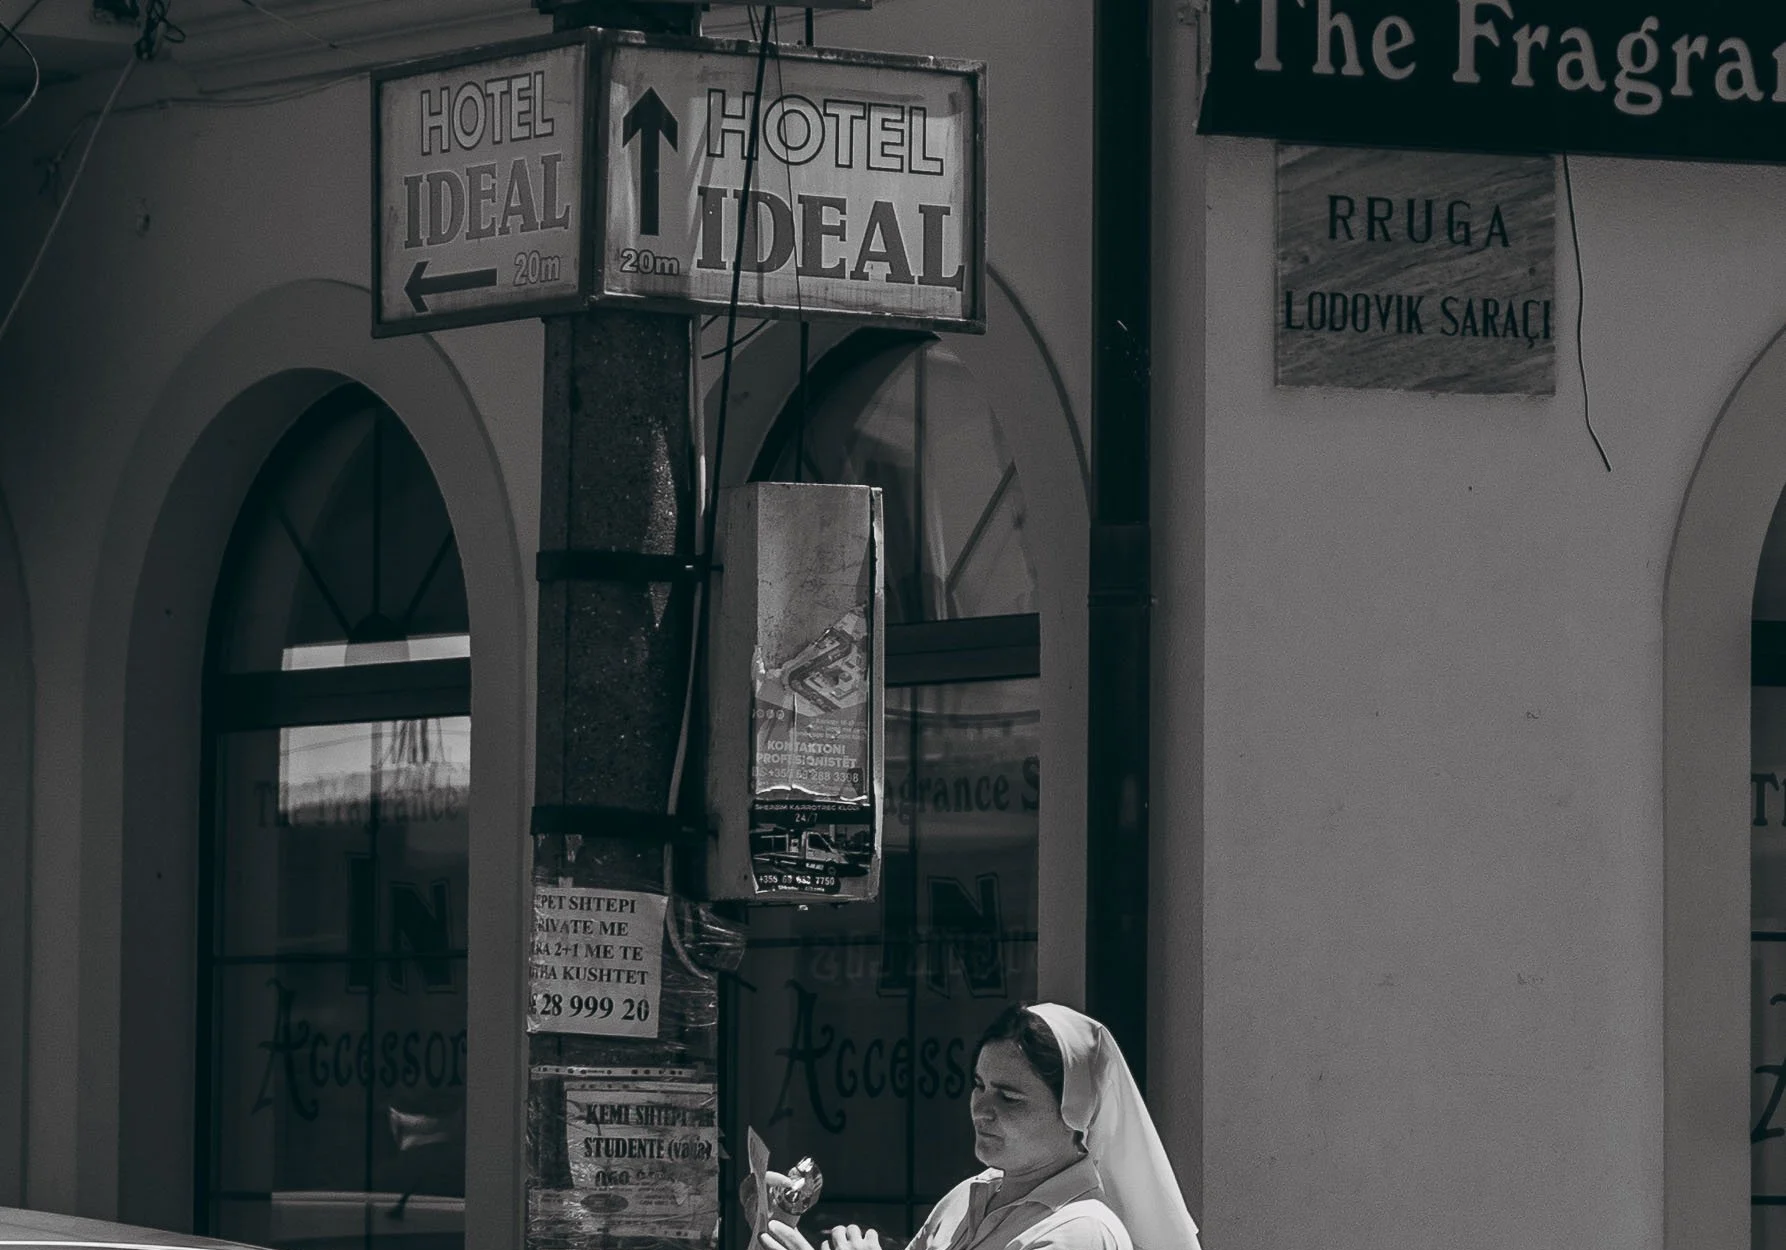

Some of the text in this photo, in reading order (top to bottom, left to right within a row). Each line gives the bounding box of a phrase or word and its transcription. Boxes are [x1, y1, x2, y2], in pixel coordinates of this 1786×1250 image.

[1253, 0, 1417, 80] The
[420, 70, 554, 156] HOTEL
[706, 88, 944, 177] HOTEL
[403, 153, 570, 249] IDEAL
[1327, 194, 1512, 249] RRUGA
[697, 185, 966, 292] IDEAL
[514, 250, 561, 287] 20m
[620, 248, 680, 276] 20m
[1284, 291, 1552, 349] LODOVIK SARAÇI
[795, 812, 818, 823] 24/7
[569, 895, 637, 913] SHTEPI
[599, 921, 629, 936] ME
[554, 942, 579, 957] 2+1
[585, 944, 614, 959] ME
[619, 946, 643, 961] TE
[563, 966, 649, 985] KUSHTET
[569, 995, 614, 1019] 999
[621, 997, 650, 1022] 20
[586, 1104, 630, 1125] KEMI
[584, 1136, 665, 1159] STUDENTE
